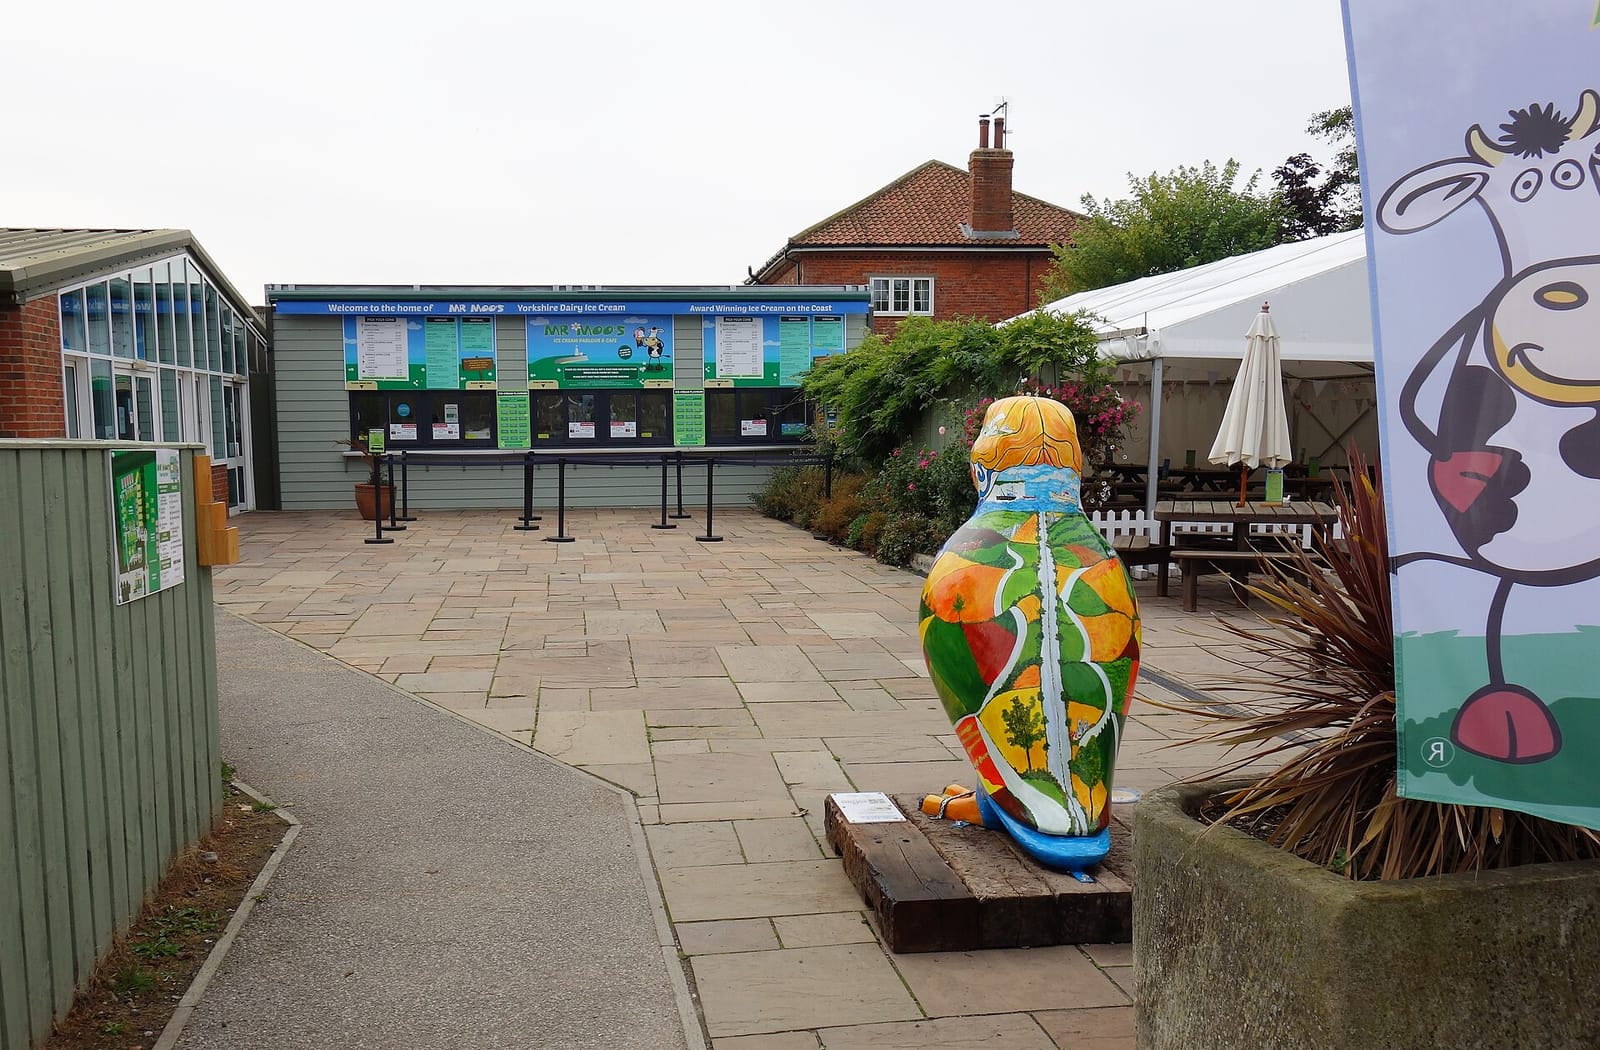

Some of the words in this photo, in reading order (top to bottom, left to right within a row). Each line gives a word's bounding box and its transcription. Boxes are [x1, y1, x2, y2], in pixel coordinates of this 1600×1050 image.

[328, 303, 368, 312] Welcome
[370, 304, 380, 312] to
[381, 303, 396, 312] the
[397, 303, 421, 312] home
[423, 303, 434, 312] of
[449, 304, 466, 313] MR
[517, 303, 558, 313] Yorkshire
[560, 304, 583, 314] Dairy
[585, 304, 597, 312] Ice
[598, 303, 626, 312] Cream
[689, 304, 714, 312] Award
[716, 304, 747, 314] Winning
[749, 304, 759, 312] Ice
[760, 304, 785, 312] Cream
[797, 304, 810, 312] the
[811, 304, 832, 312] Coast
[544, 324, 569, 336] MR
[576, 324, 626, 337] MOO'S
